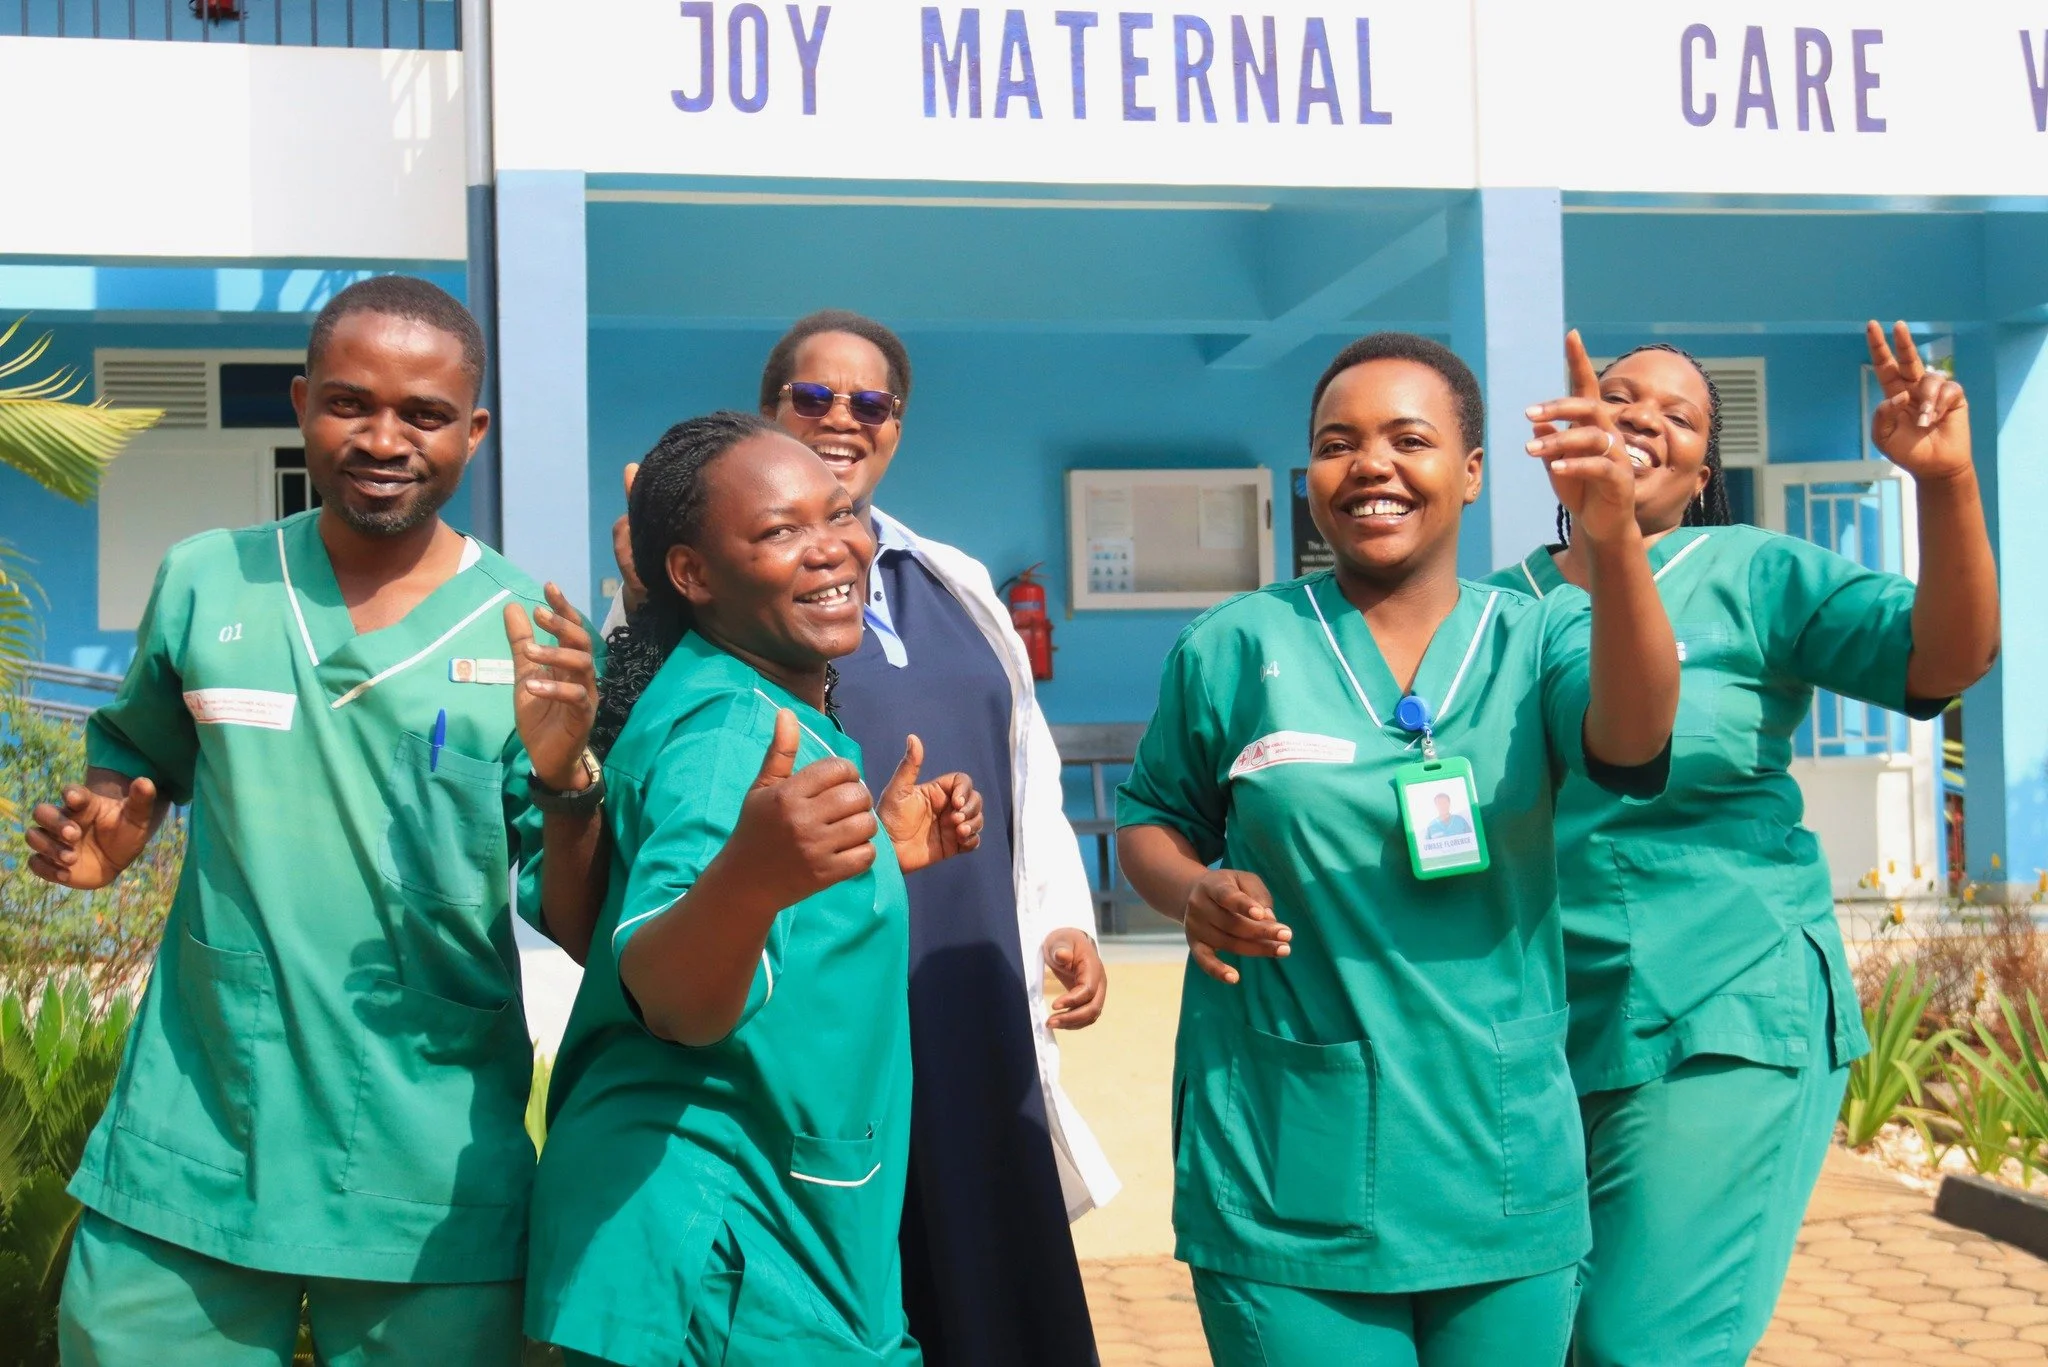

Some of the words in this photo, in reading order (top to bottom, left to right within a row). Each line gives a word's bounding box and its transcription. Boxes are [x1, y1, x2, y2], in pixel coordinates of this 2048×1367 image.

[671, 1, 831, 115] JOY
[921, 6, 1392, 125] MATERNAL
[1681, 23, 1887, 132] CARE
[219, 622, 243, 642] 01
